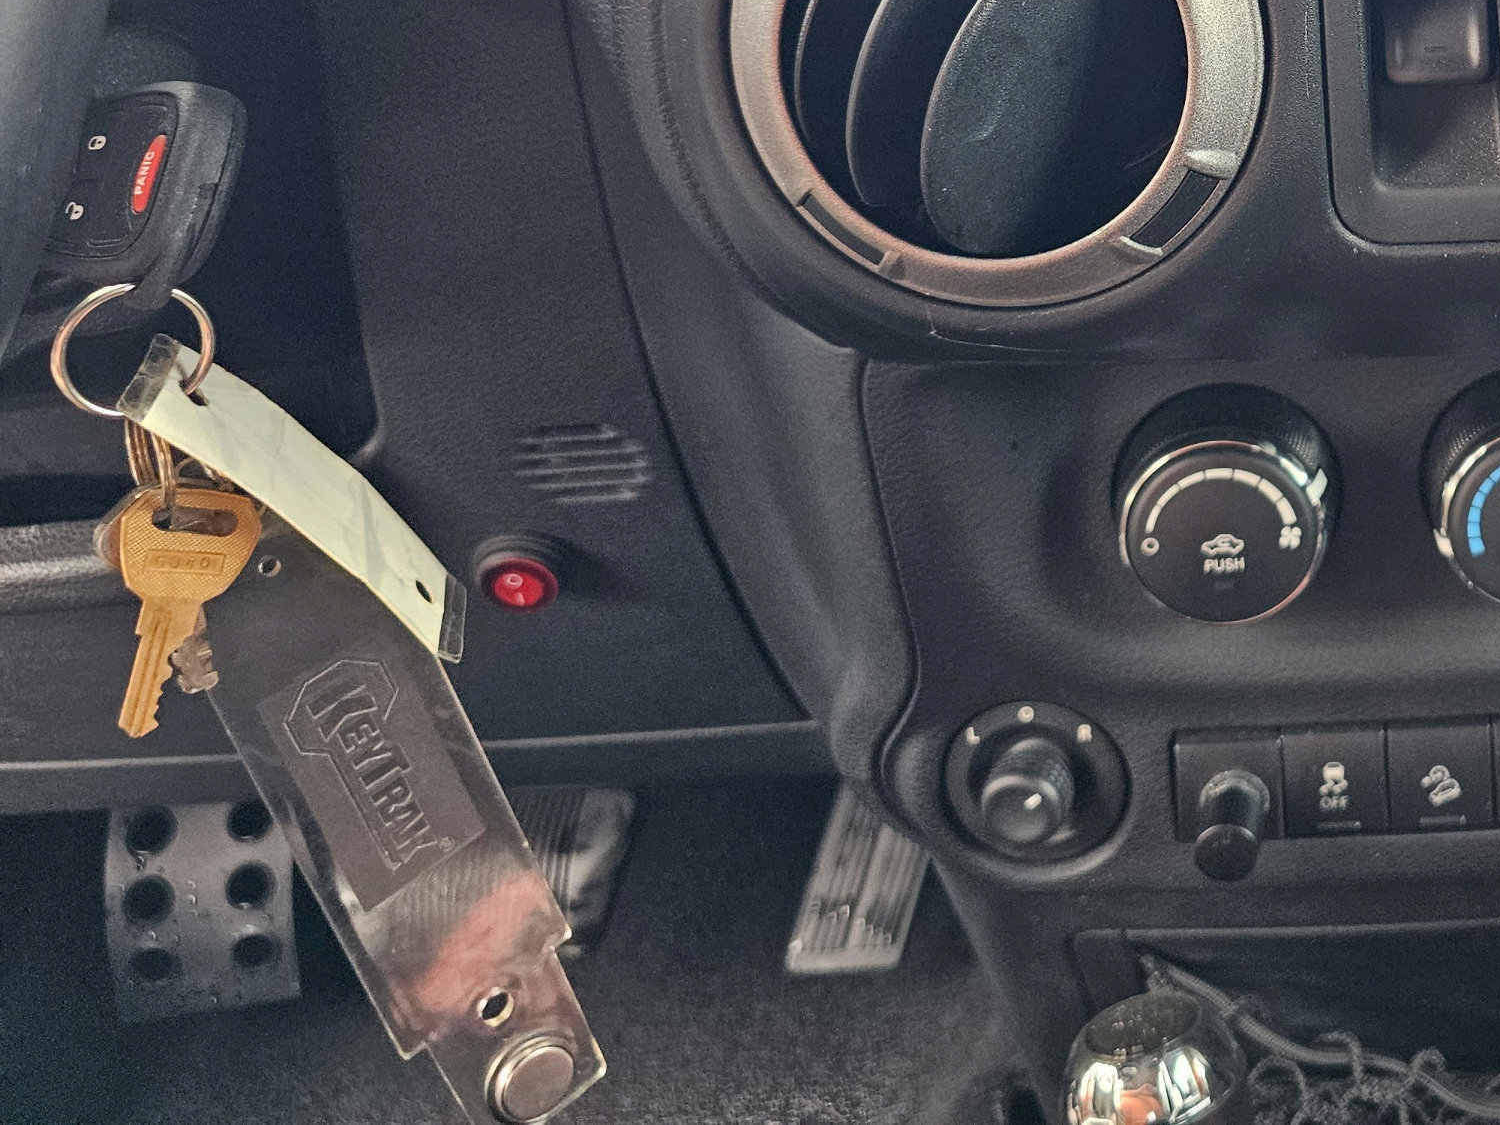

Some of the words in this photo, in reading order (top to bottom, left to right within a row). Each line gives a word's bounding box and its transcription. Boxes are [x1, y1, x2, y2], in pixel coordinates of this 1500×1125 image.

[133, 151, 156, 195] PANIC
[1203, 556, 1246, 575] PUSH
[1320, 795, 1349, 813] OFF
